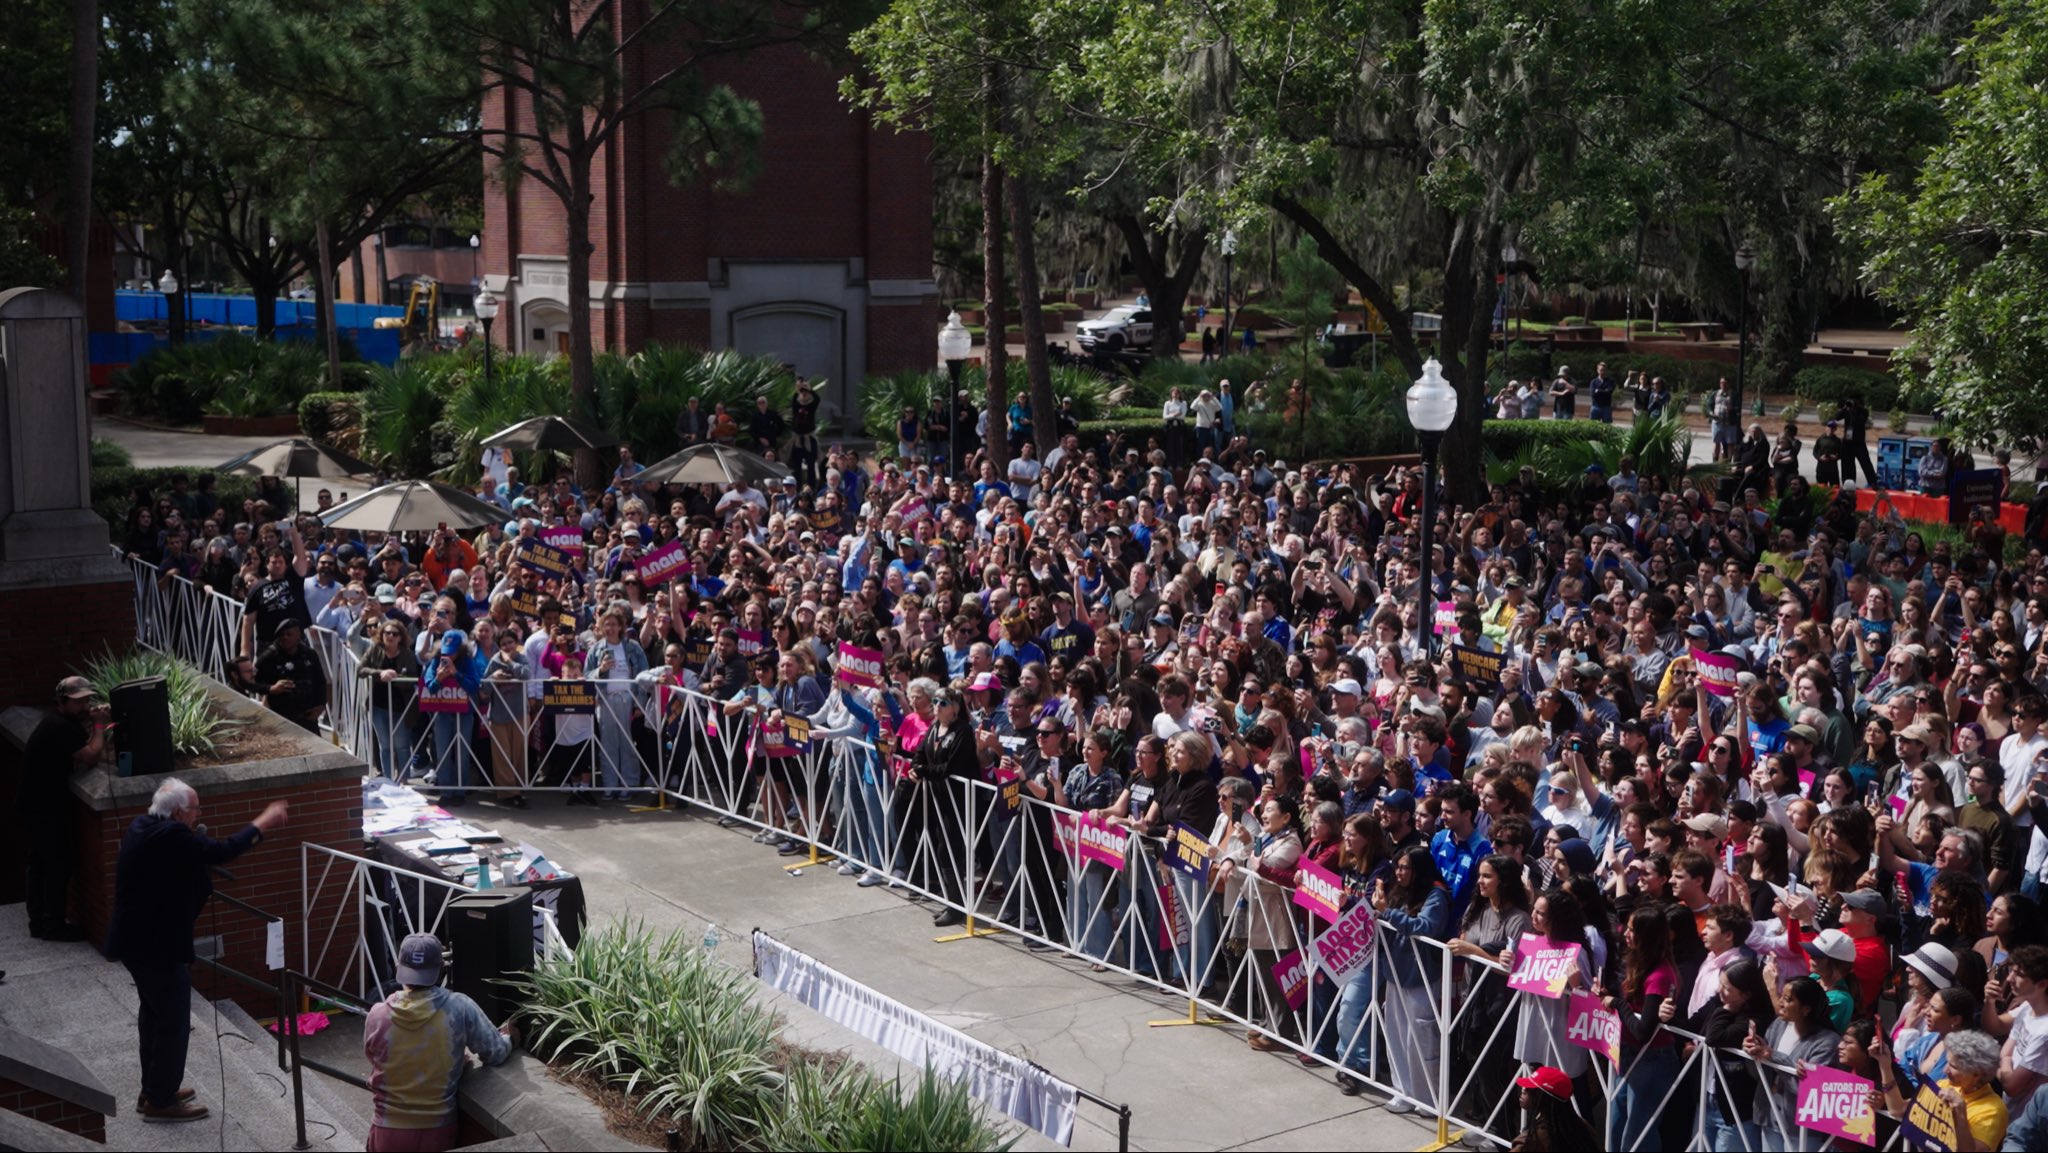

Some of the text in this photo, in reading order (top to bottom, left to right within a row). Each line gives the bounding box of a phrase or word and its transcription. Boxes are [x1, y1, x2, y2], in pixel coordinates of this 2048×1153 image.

[1178, 844, 1191, 865] FOR
[1190, 852, 1202, 871] ALL
[1536, 947, 1563, 959] GATORS
[1336, 957, 1351, 977] FOR
[1822, 1081, 1869, 1094] GATORS FOR
[1799, 1088, 1868, 1122] ANGIE
